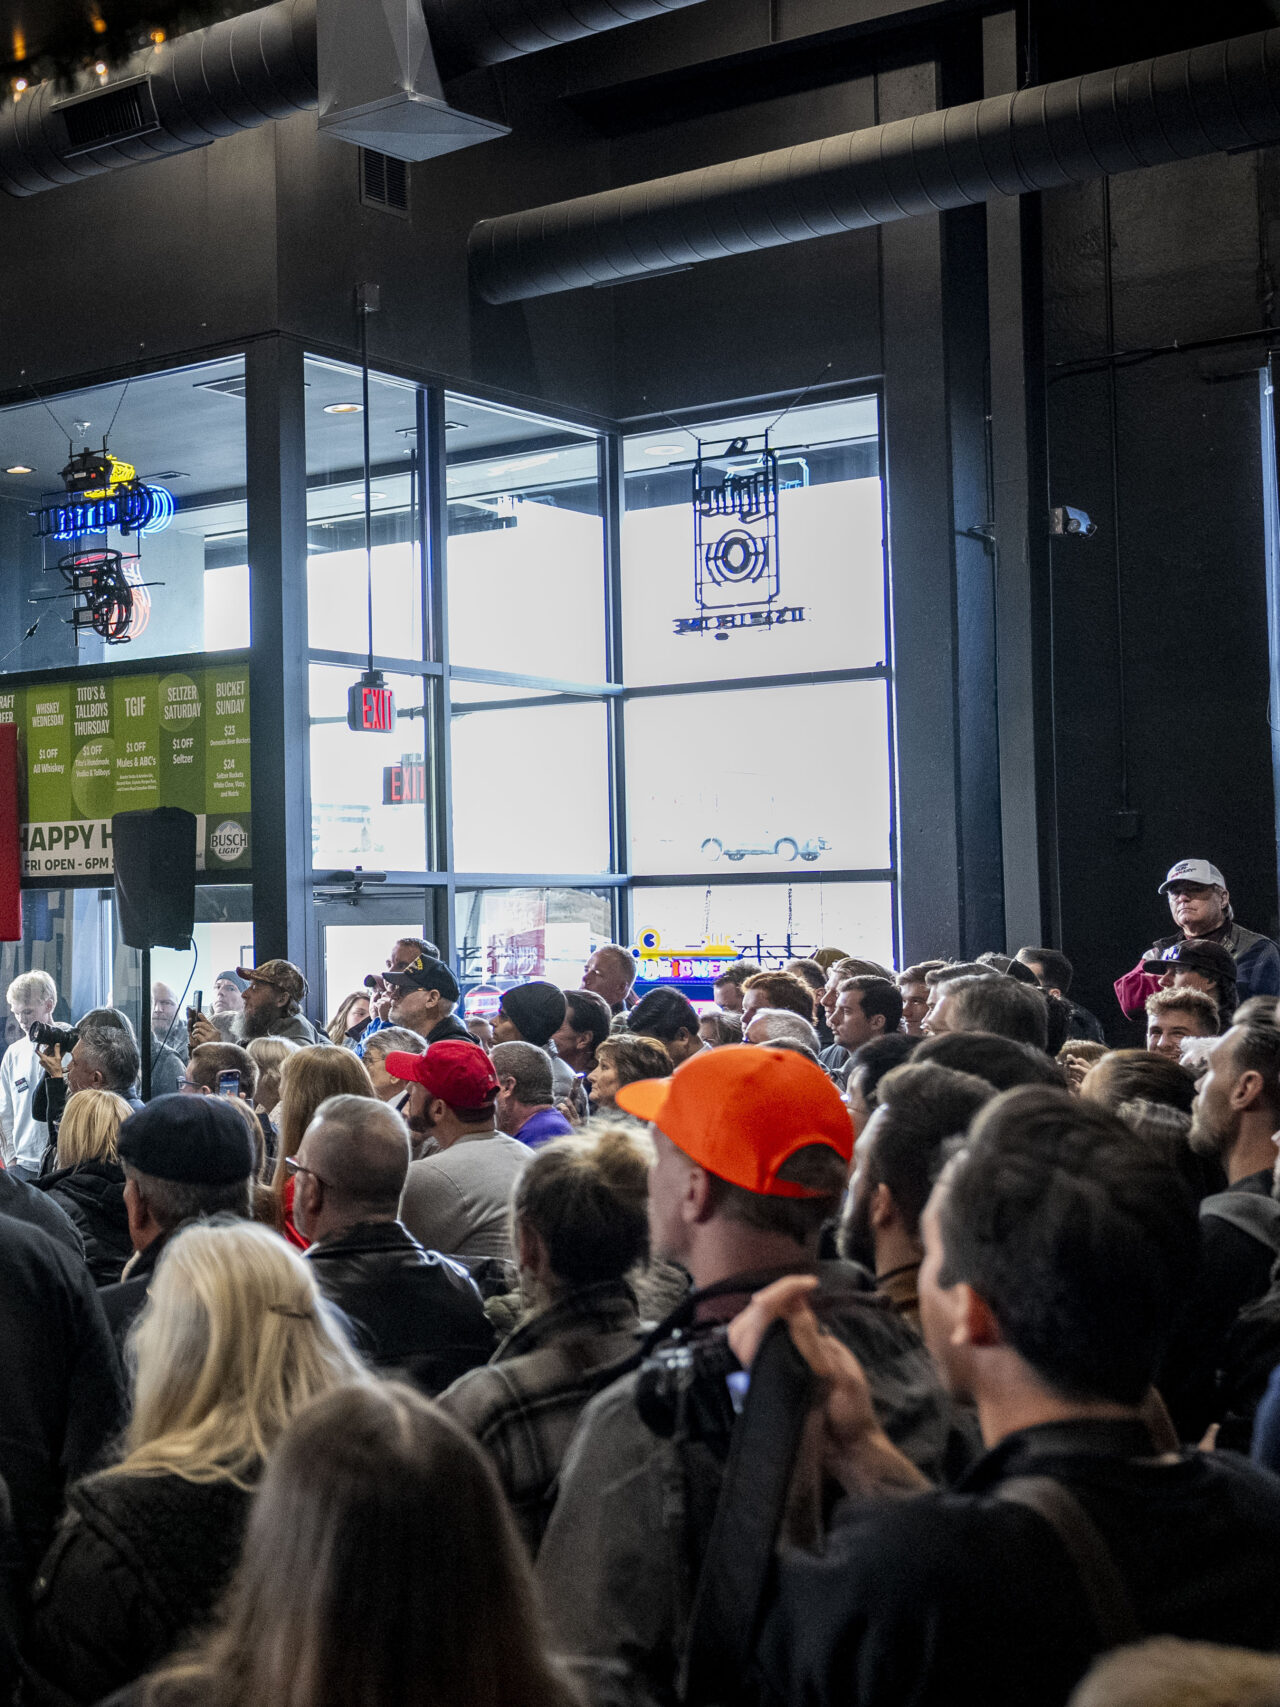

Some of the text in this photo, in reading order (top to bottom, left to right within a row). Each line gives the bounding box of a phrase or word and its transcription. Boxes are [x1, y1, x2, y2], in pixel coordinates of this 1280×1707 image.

[77, 685, 106, 701] TITO'S &
[167, 685, 197, 702] SELTZER
[215, 681, 245, 698] BUCKET
[36, 702, 60, 715] WHISKEY
[75, 703, 108, 719] TALLBOYS
[125, 696, 146, 717] TGIF
[164, 703, 202, 720] SATURDAY
[215, 699, 245, 715] SUNDAY
[362, 688, 392, 730] EXIT
[32, 714, 64, 727] WEDNESDAY
[74, 720, 110, 736] THURSDAY
[91, 745, 103, 755] OFF
[126, 742, 146, 753] $1 OFF
[173, 738, 194, 750] $1 OFF
[39, 748, 58, 759] $1 OFF
[172, 754, 193, 764] Seltzer
[33, 763, 65, 775] All Whiskey
[223, 759, 235, 770] $24
[391, 766, 425, 800] EXIT
[20, 824, 94, 851] HAPPY
[211, 834, 247, 848] BUSCH
[218, 847, 240, 855] LIGHT
[24, 860, 41, 871] FRI
[45, 859, 75, 871] OPEN
[85, 857, 108, 869] 6PM
